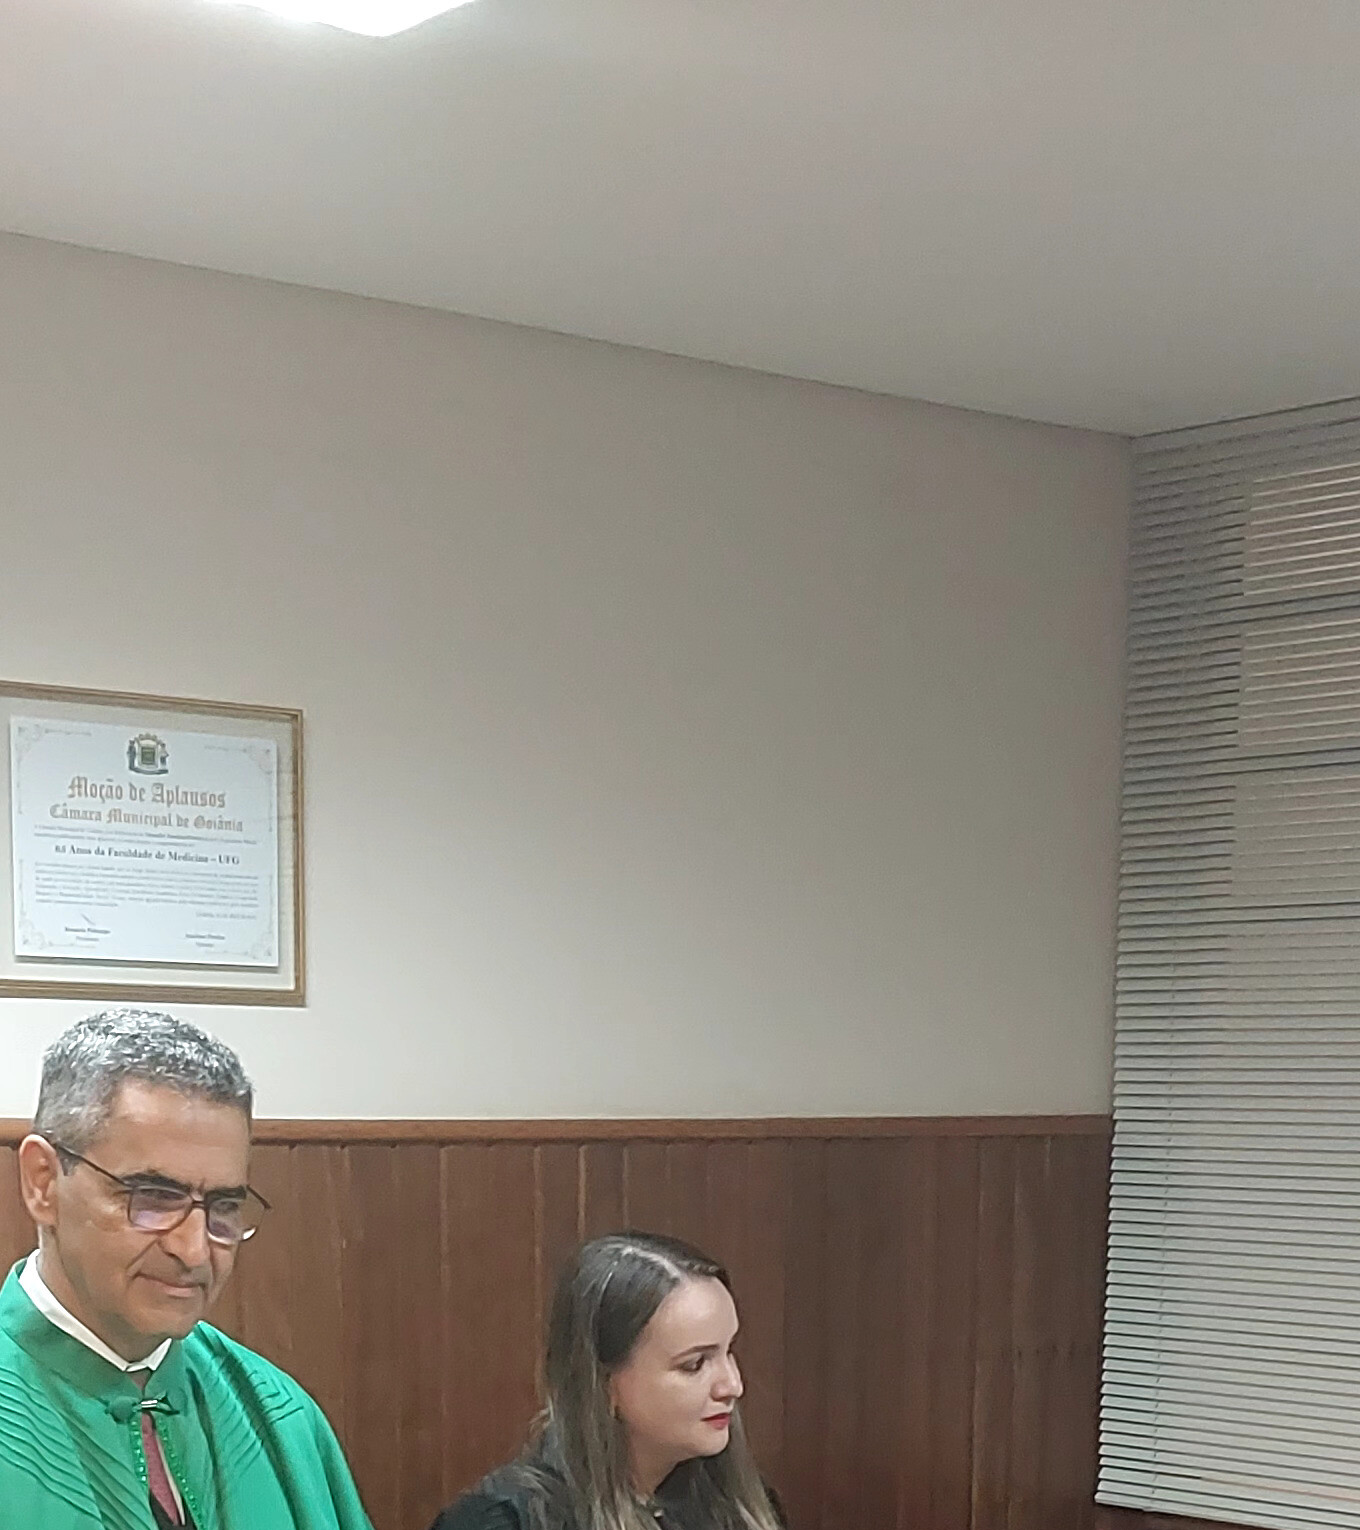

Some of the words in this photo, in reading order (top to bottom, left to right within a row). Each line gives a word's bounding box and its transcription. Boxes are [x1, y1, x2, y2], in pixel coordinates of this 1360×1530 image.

[68, 776, 123, 803] Moção
[128, 782, 145, 801] de
[151, 782, 226, 808] Aplausos
[49, 802, 102, 821] Câmara
[106, 808, 172, 827] Municipal
[176, 814, 189, 827] de
[193, 815, 243, 832] Goiânia
[108, 847, 152, 859] Faculdade
